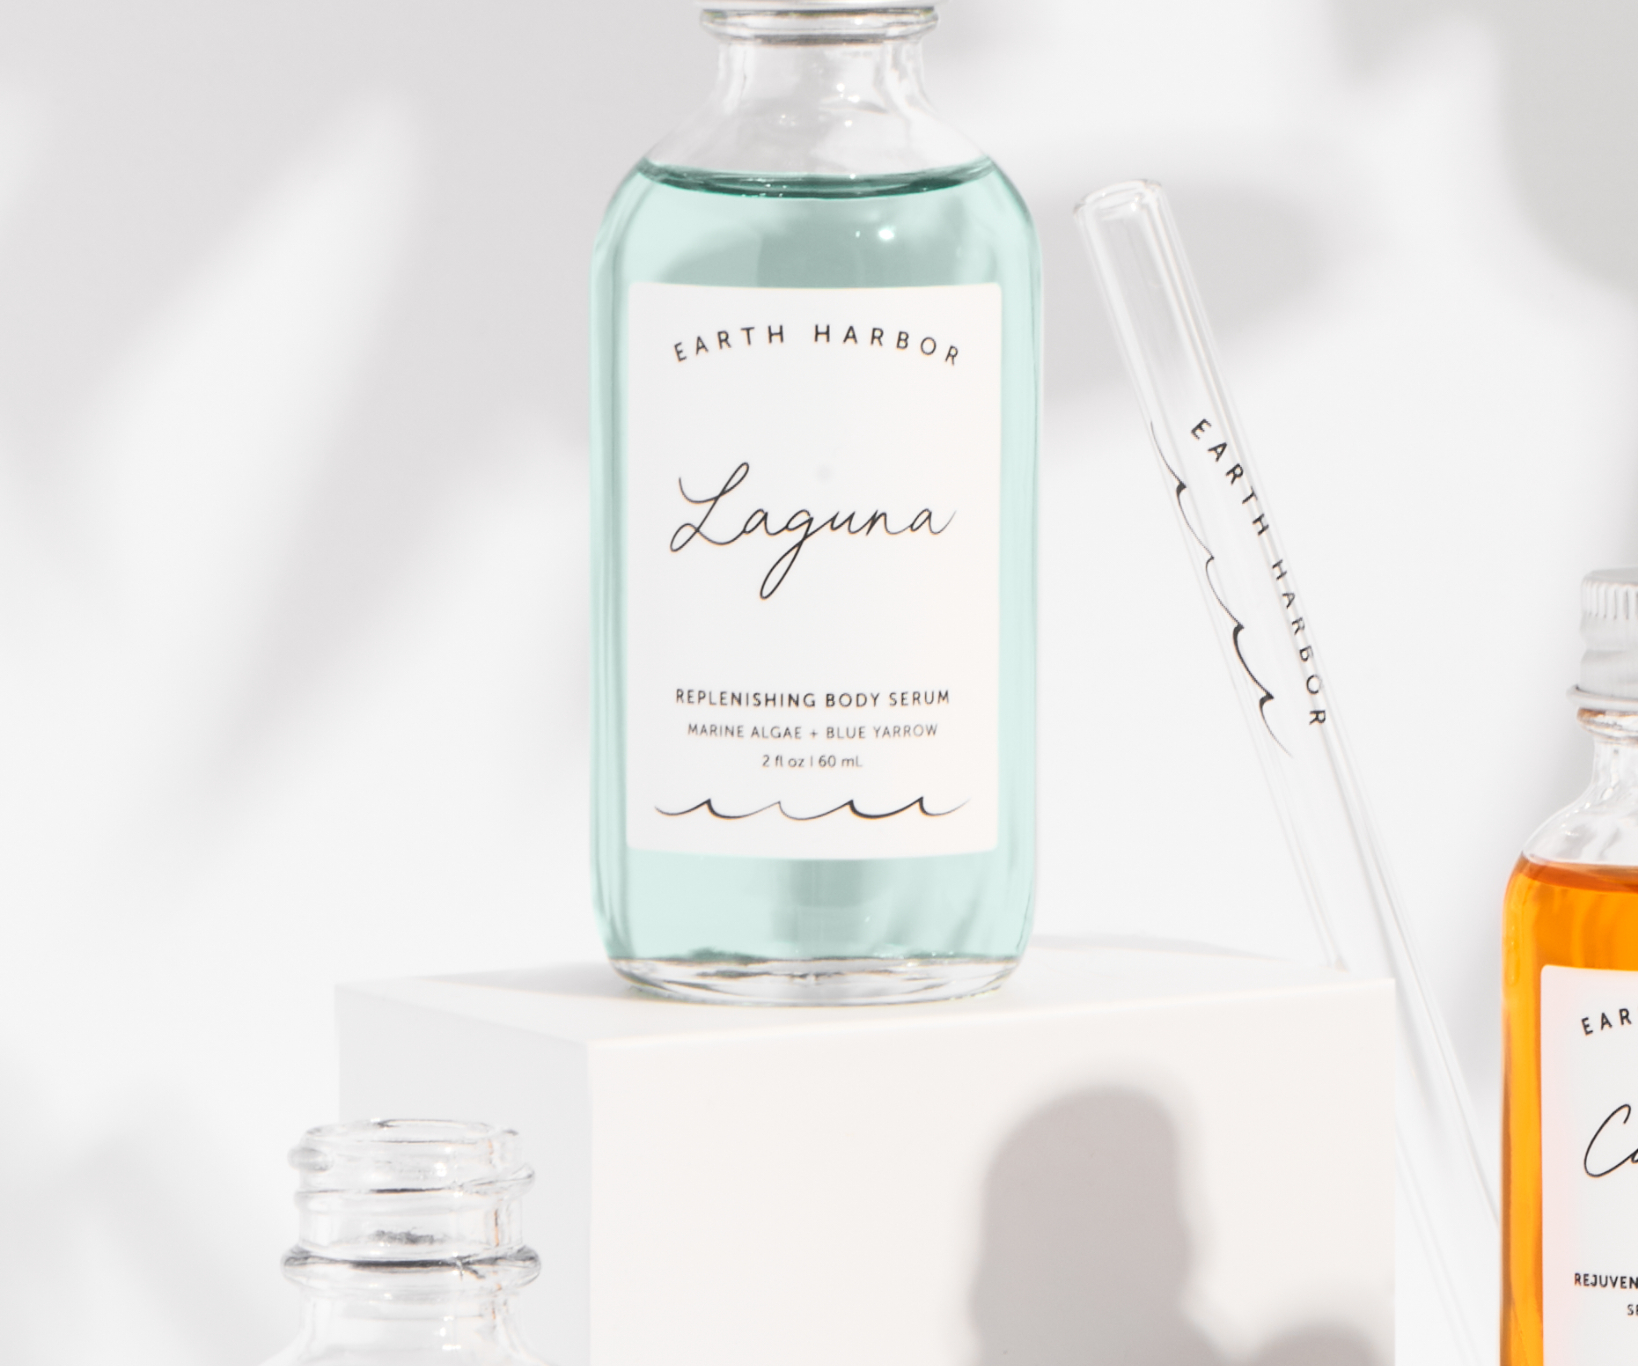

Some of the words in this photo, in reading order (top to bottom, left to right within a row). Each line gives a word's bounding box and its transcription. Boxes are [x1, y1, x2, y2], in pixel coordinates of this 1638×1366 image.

[673, 324, 785, 363] EARTH
[813, 323, 959, 365] HARBOR
[669, 461, 956, 601] Laguna
[1191, 419, 1269, 536] EARTH
[1272, 559, 1327, 726] HARBOR
[675, 688, 816, 708] REPLENISHING
[825, 692, 880, 708] BODY
[888, 689, 949, 707] SERUM
[687, 723, 744, 739] MARINE
[750, 725, 801, 740] ALGAE
[810, 729, 818, 738] +
[825, 725, 865, 740] BLUE
[873, 723, 938, 738] YARROW
[761, 753, 771, 768] 2
[774, 754, 784, 767] fl
[787, 757, 806, 769] oz
[817, 754, 837, 768] 60
[840, 755, 861, 768] mL
